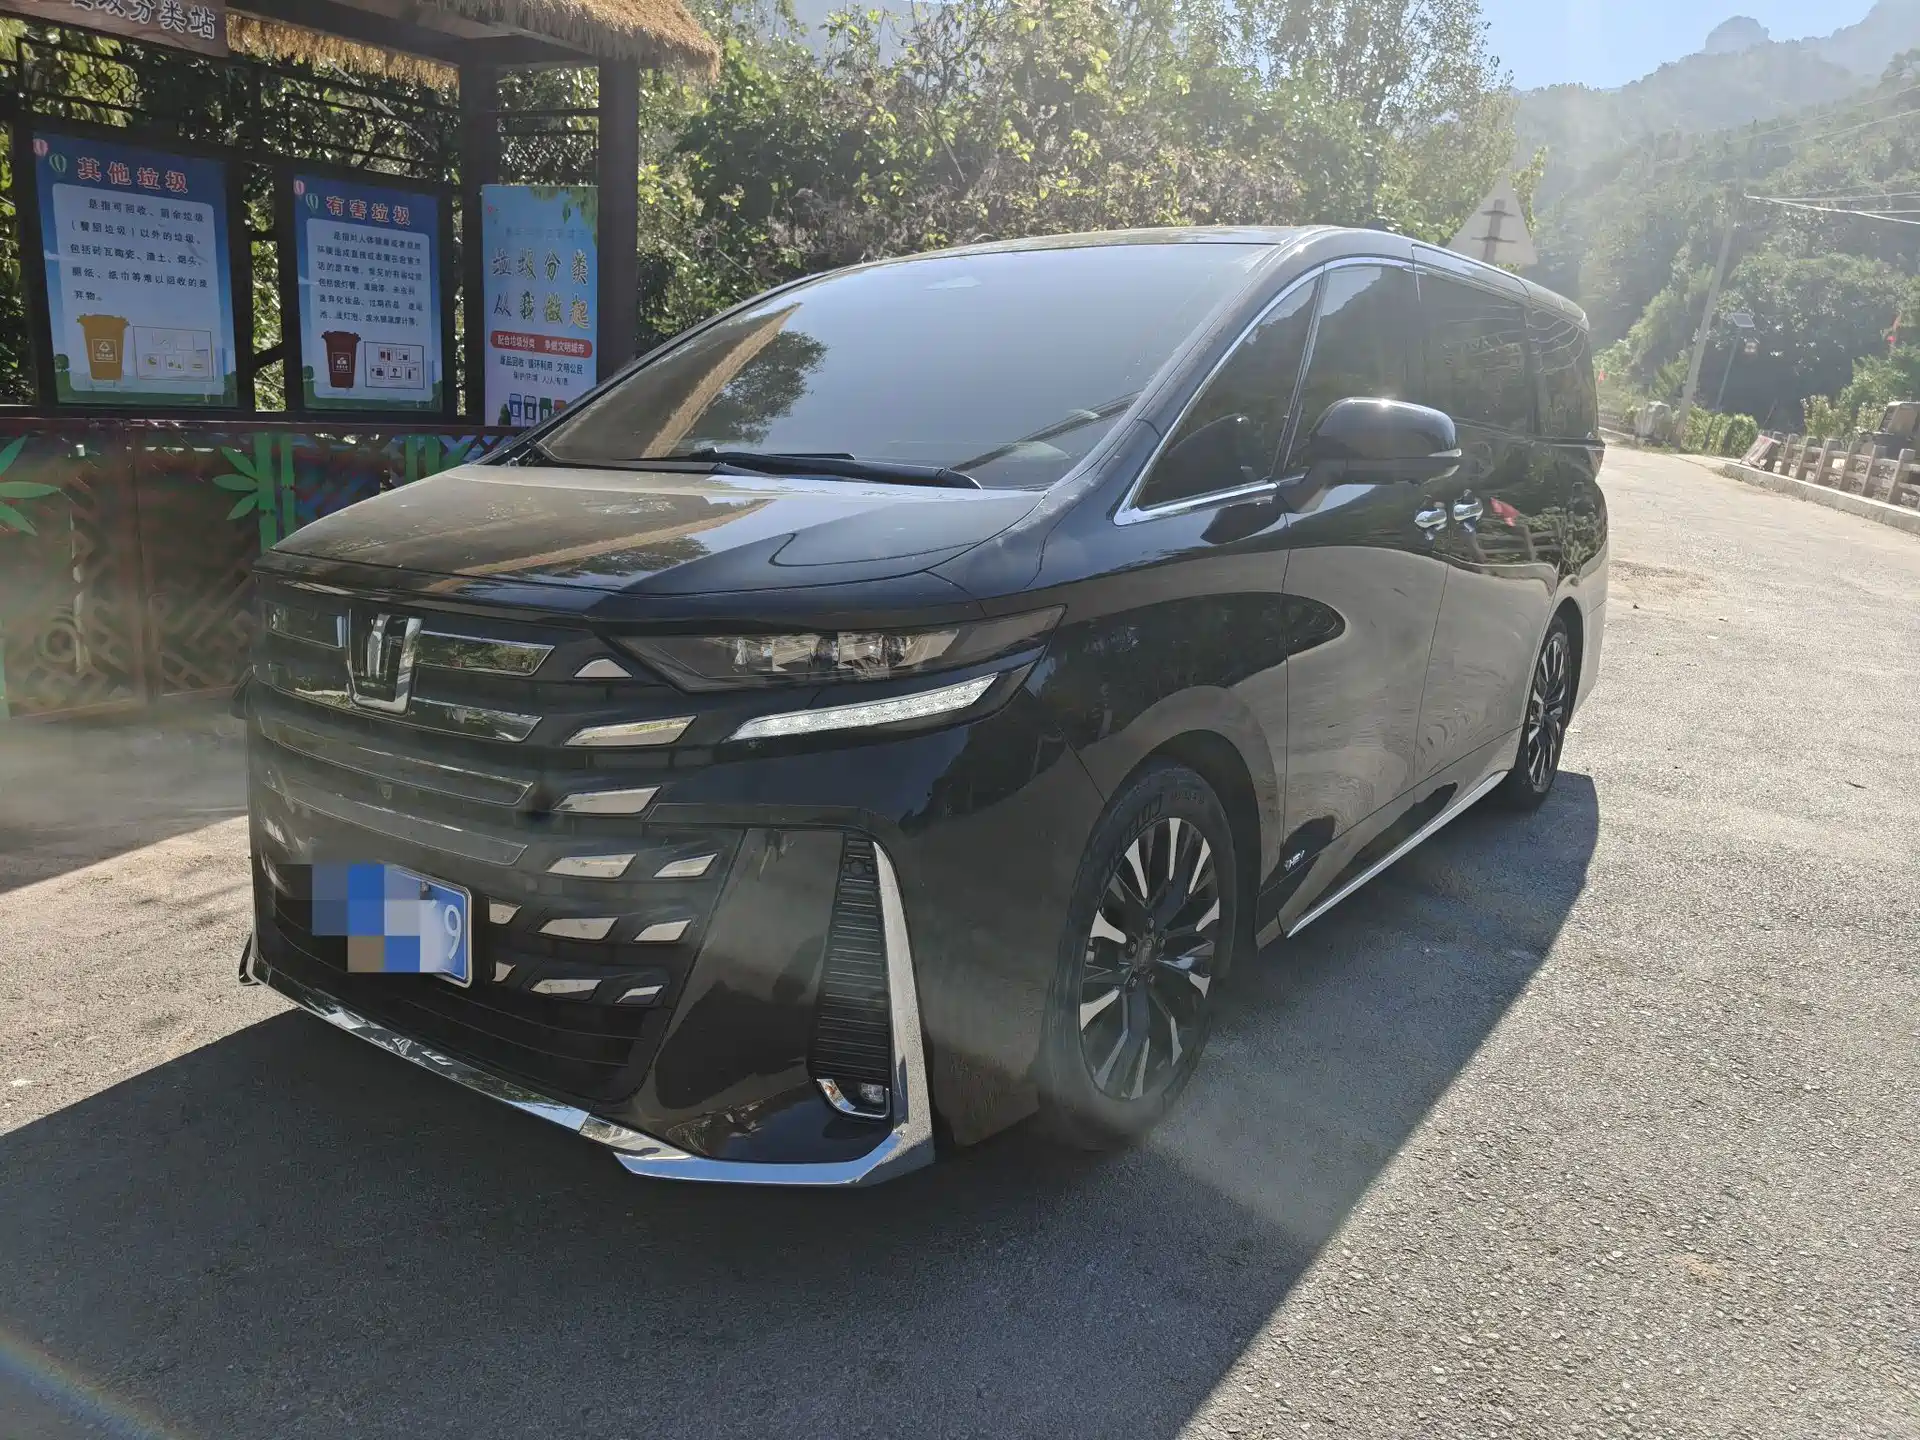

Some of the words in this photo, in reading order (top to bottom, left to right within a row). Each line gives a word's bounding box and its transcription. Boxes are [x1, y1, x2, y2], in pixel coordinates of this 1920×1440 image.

[77, 156, 188, 193] 其他垃圾
[326, 196, 411, 226] 有害垃圾
[492, 248, 588, 285] 垃圾分类
[493, 291, 590, 329] 从我做起
